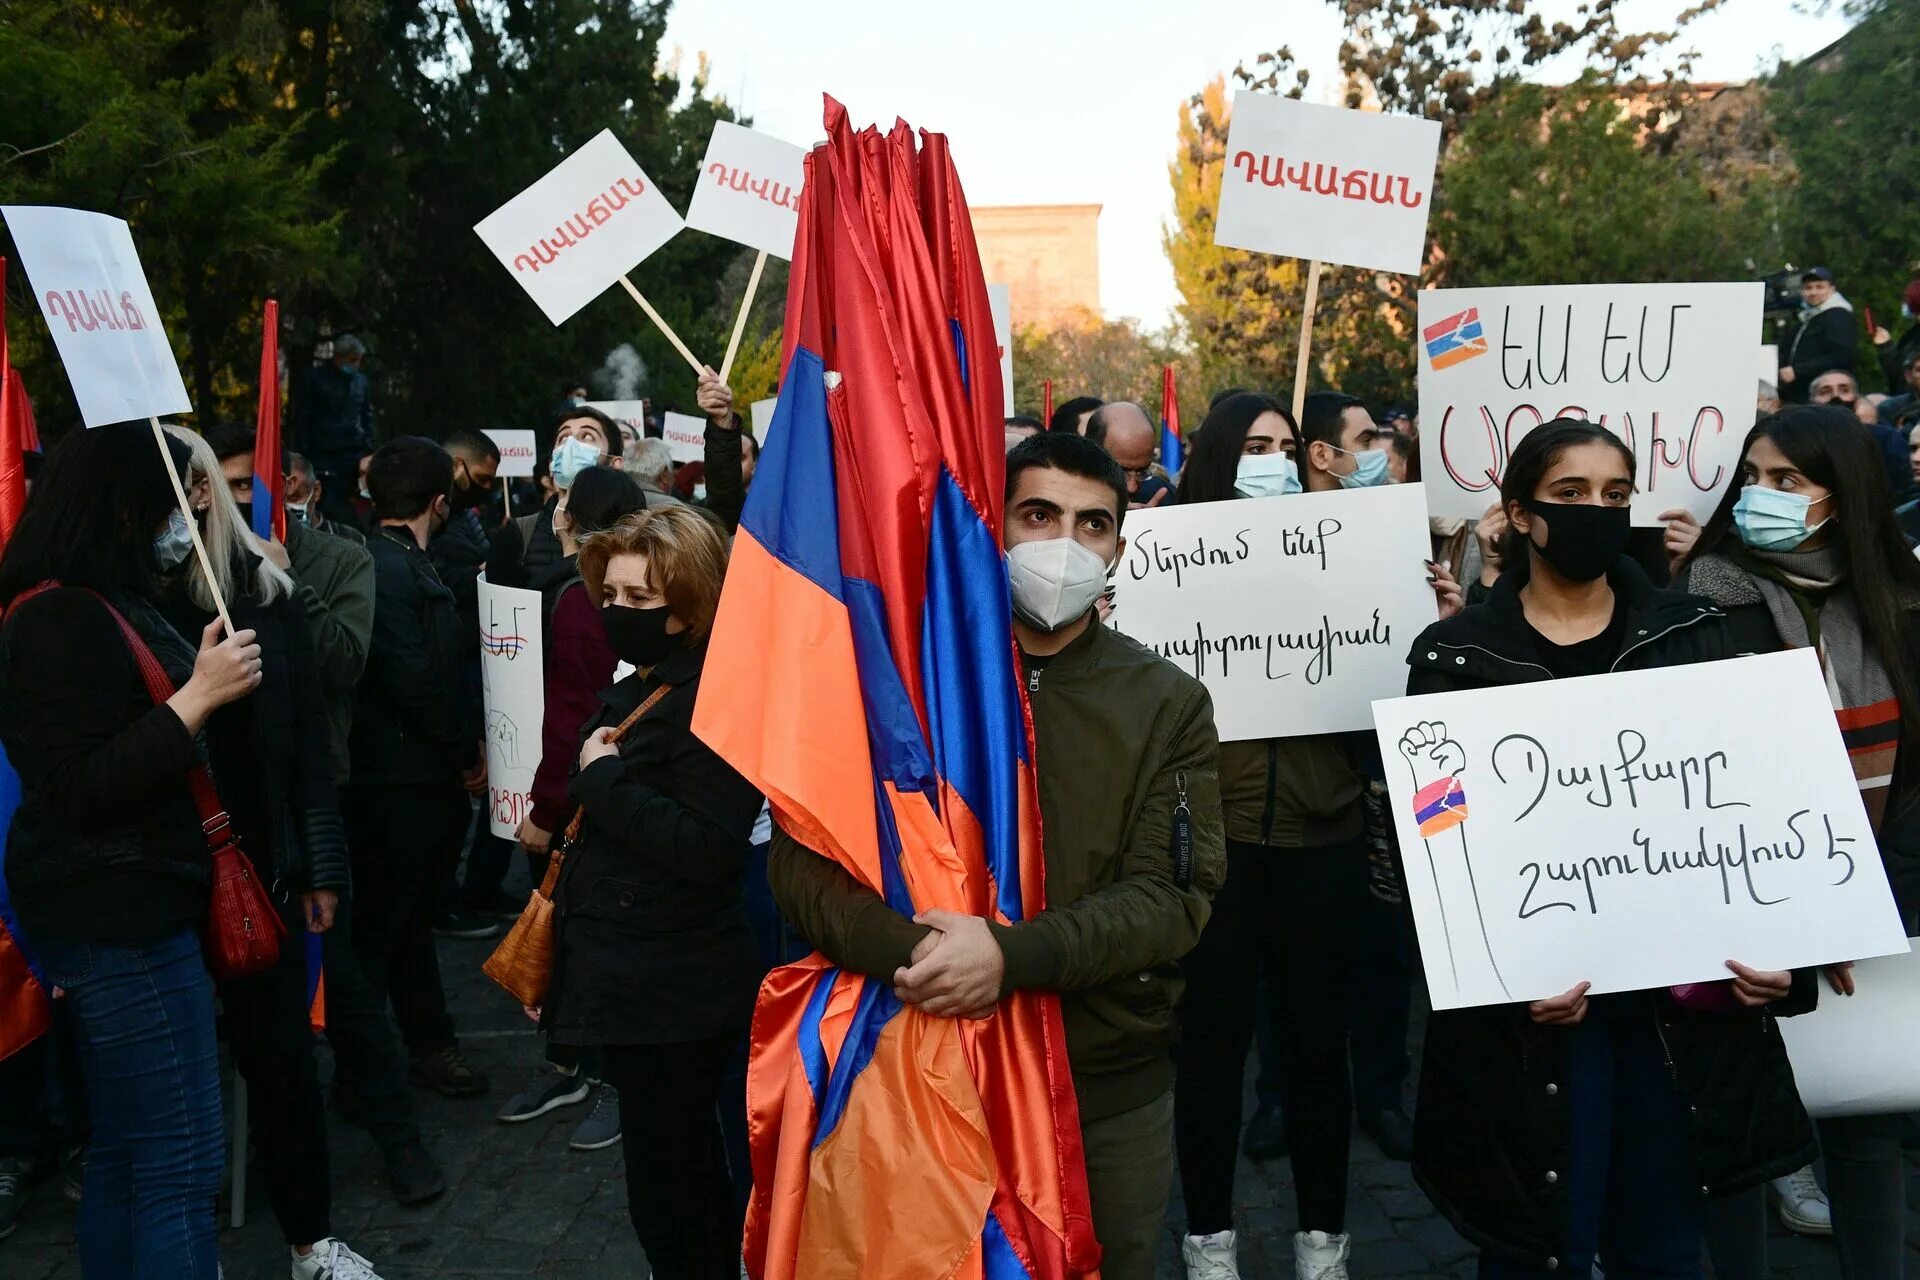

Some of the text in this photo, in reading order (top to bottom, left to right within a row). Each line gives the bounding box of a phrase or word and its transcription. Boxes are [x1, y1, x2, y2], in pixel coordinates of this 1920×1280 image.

[1233, 150, 1422, 208] ԴԱՎԱՃԱՆ
[513, 177, 646, 273] ԴԱՎԱՃԱՆ
[1501, 302, 1692, 390] ԵՍ ԵՄ
[1492, 729, 1751, 822] Պայքարը
